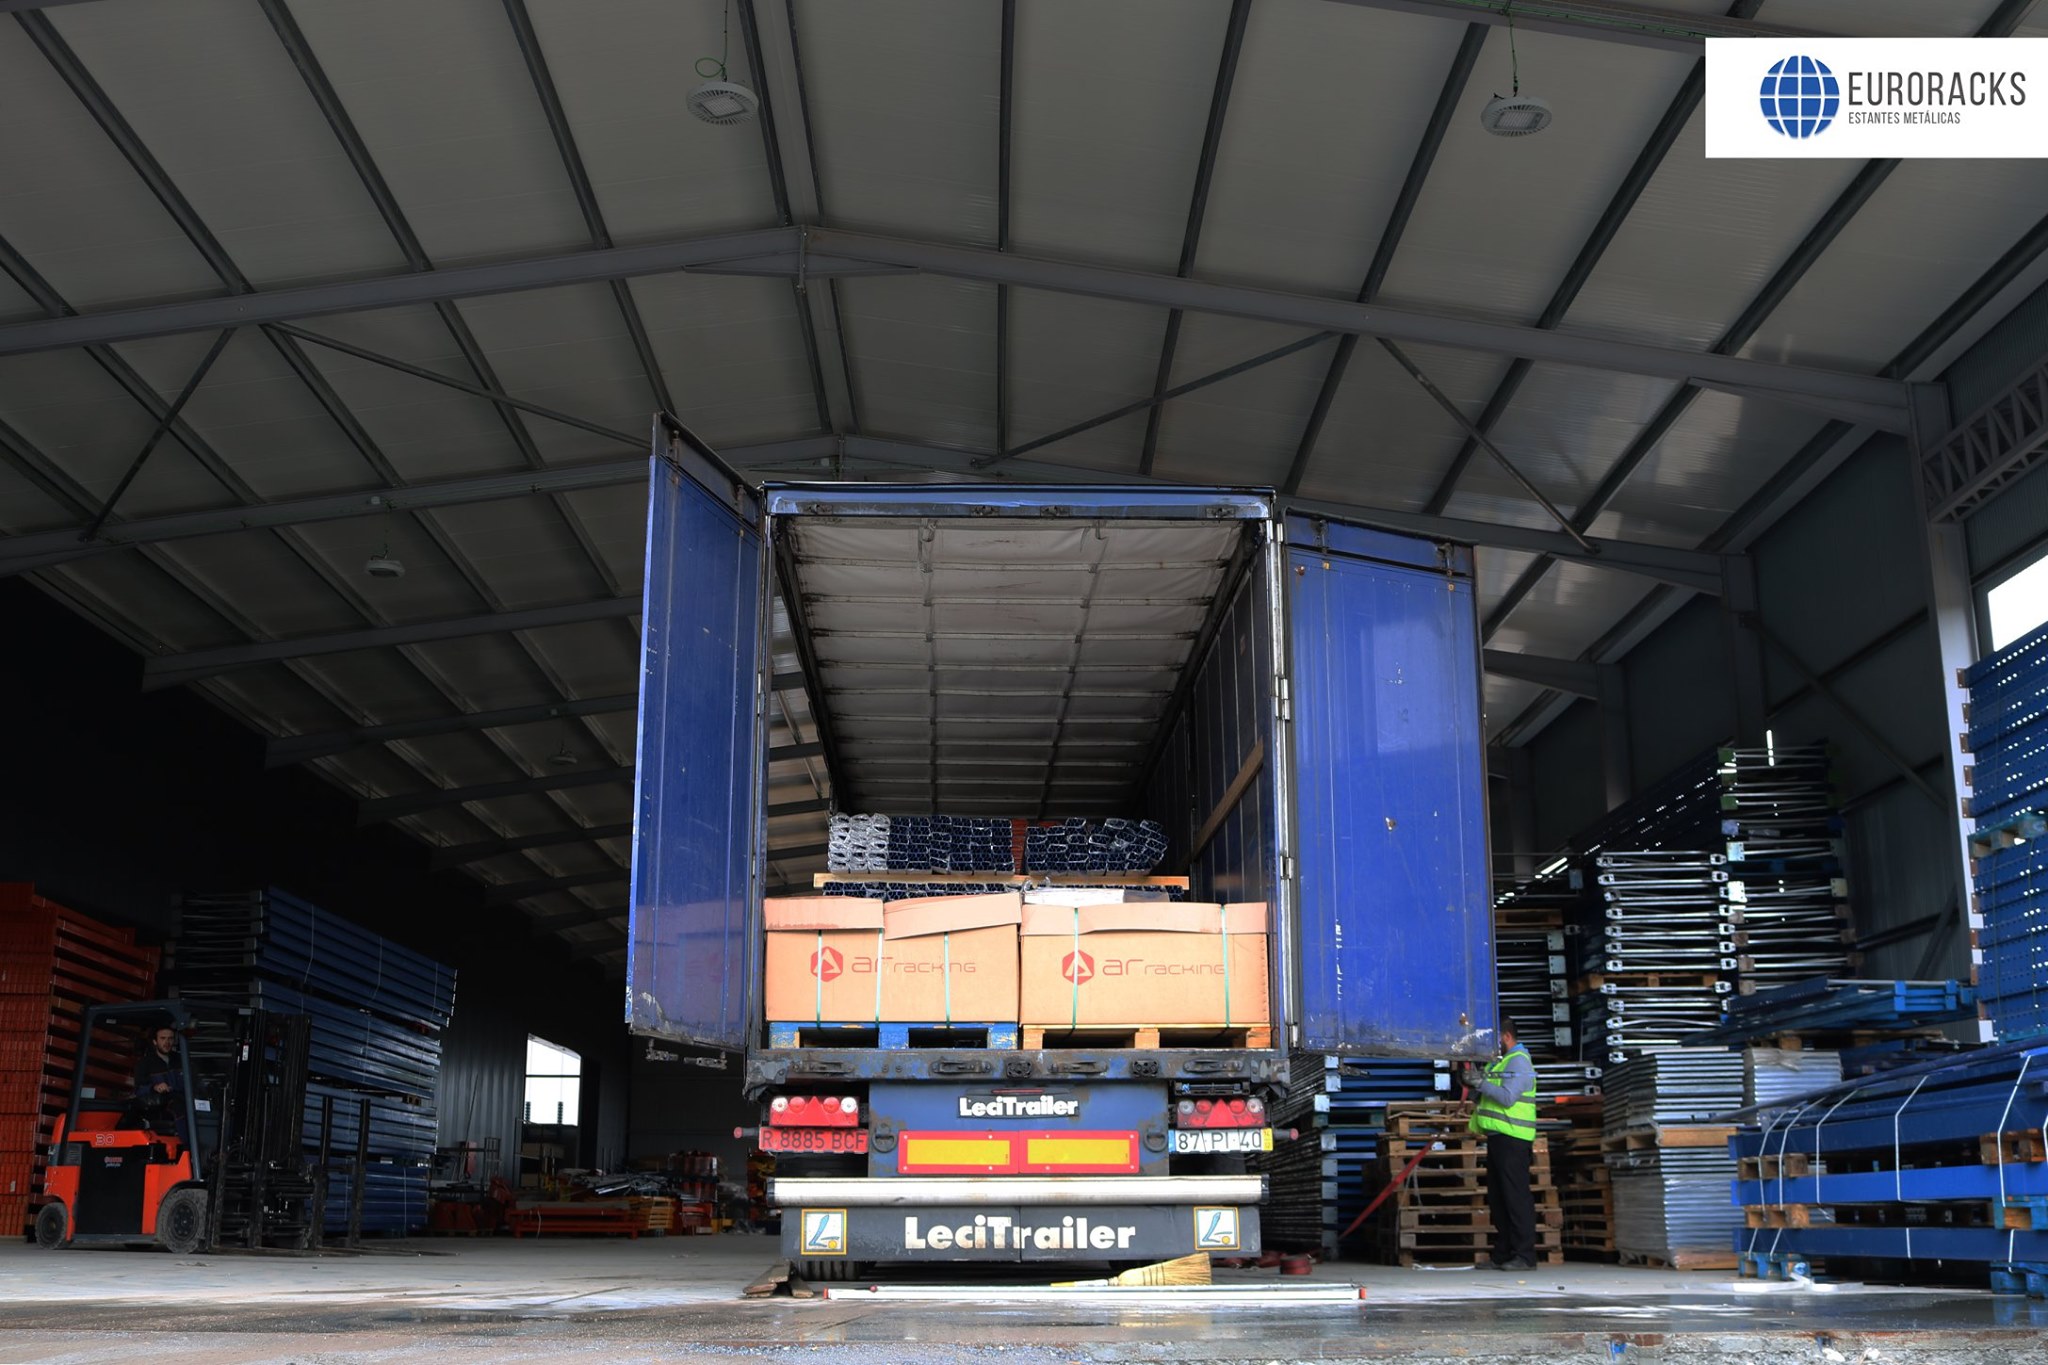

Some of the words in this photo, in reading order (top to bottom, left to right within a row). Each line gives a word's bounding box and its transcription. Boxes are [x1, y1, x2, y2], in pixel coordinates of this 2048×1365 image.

[959, 1095, 1079, 1117] LeciTrailer
[95, 1133, 115, 1146] 30
[780, 1129, 825, 1149] 8885
[831, 1130, 868, 1150] BCF
[904, 1214, 1136, 1250] LeciTrailer
